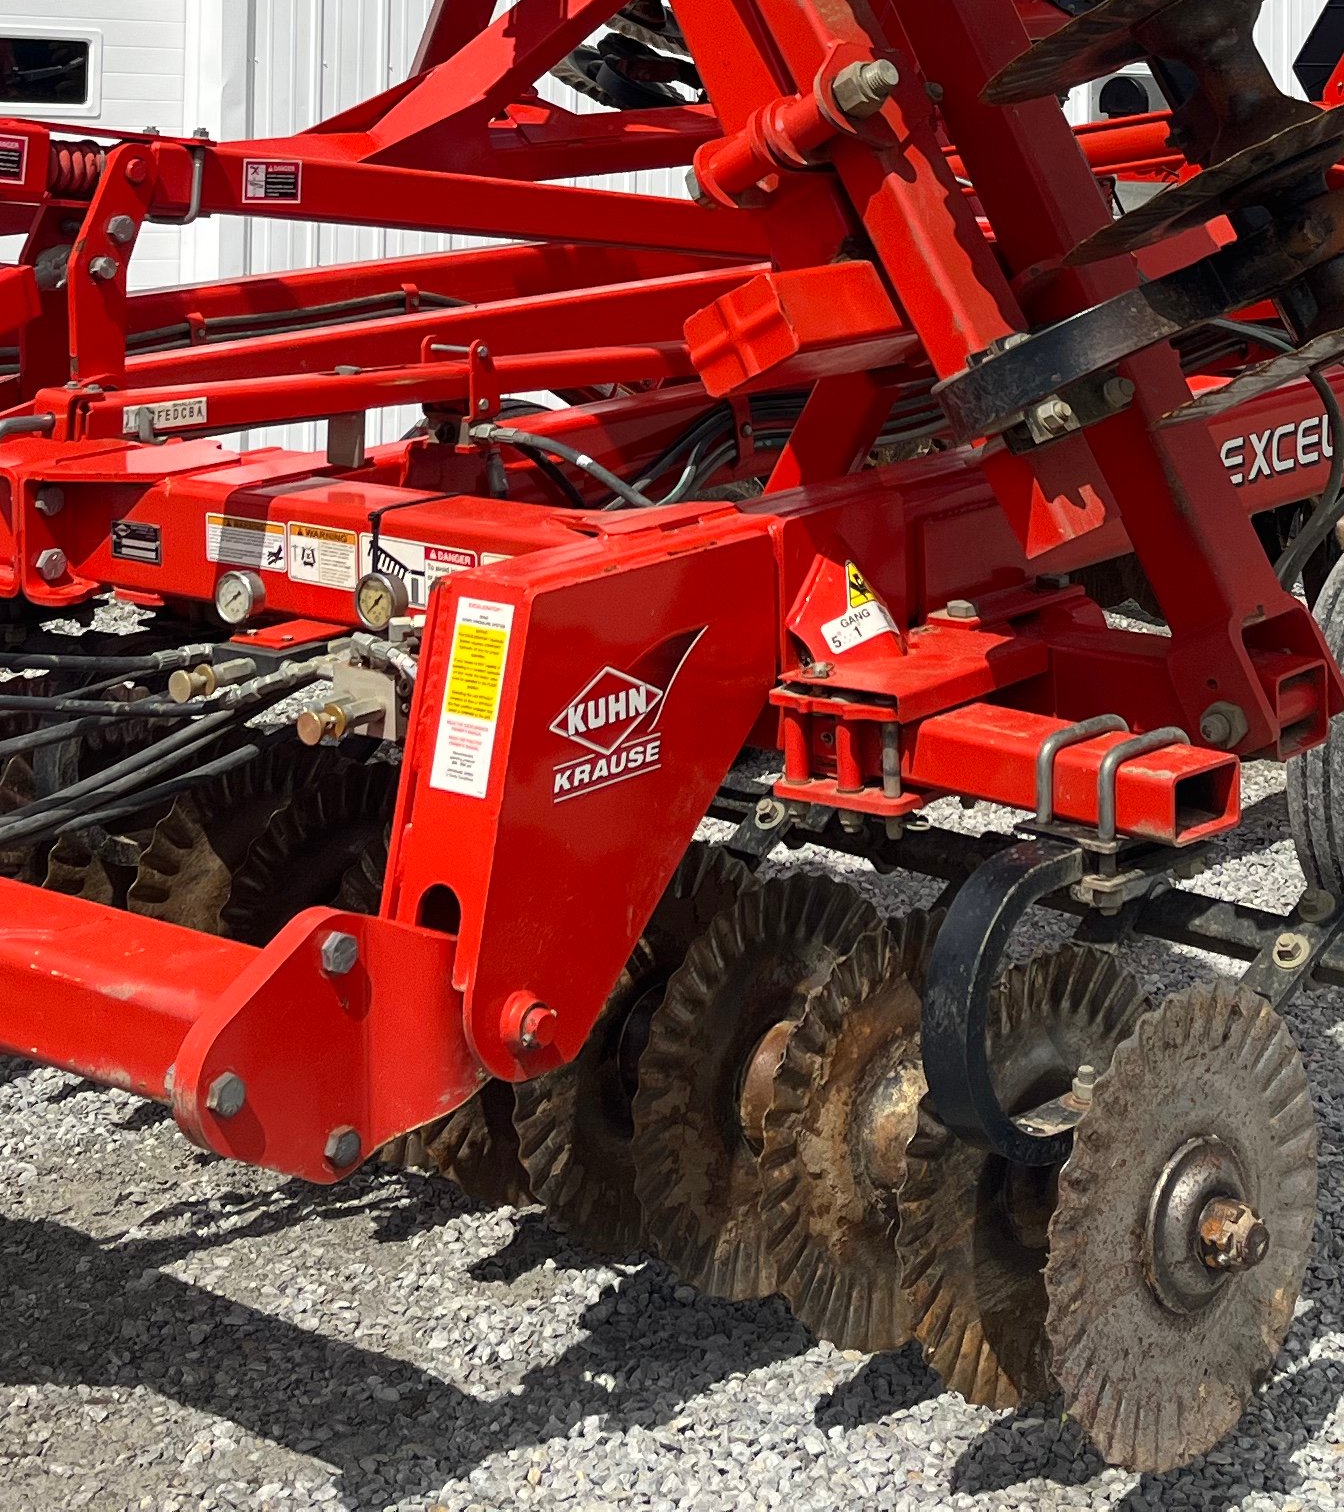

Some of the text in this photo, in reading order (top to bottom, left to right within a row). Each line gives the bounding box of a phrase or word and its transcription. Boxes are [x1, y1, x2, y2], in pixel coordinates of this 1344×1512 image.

[306, 529, 348, 542] WARNING
[437, 550, 472, 566] DANGER
[840, 608, 871, 628] GANG
[831, 625, 863, 648] 5 1
[567, 684, 648, 736] KUHN
[553, 740, 661, 794] KRAUSE
